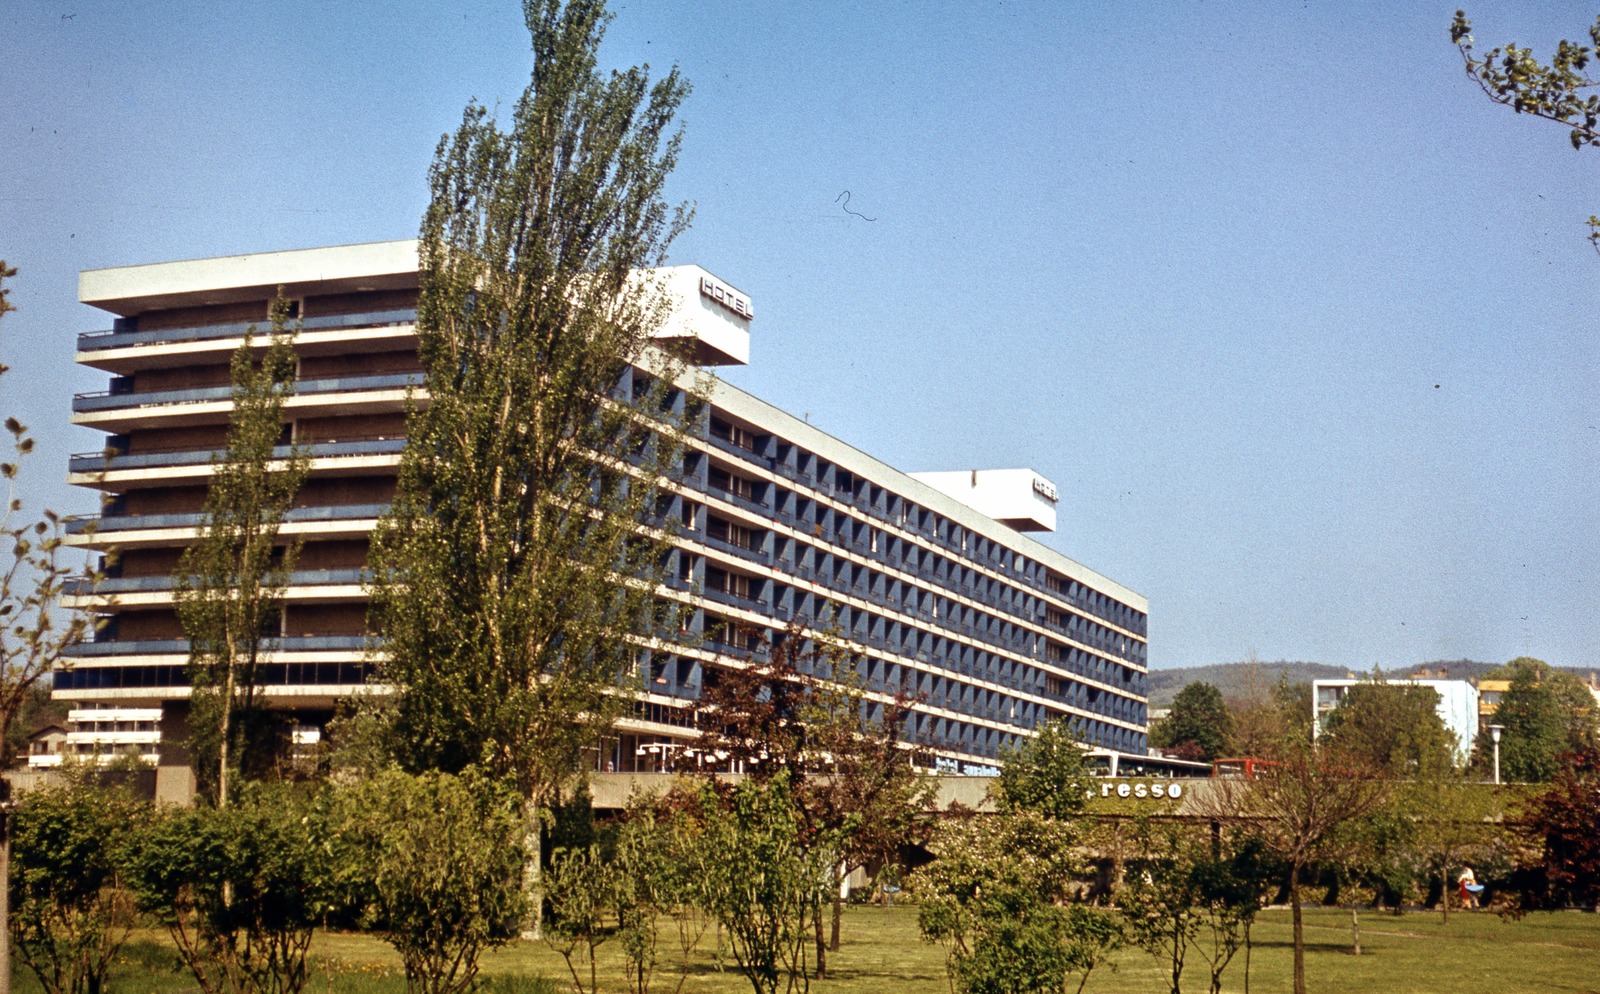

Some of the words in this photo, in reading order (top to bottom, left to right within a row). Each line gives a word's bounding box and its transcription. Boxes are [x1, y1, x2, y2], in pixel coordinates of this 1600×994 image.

[700, 277, 753, 321] HOTEL
[1033, 478, 1059, 502] HOTEL
[1069, 783, 1182, 799] resso
